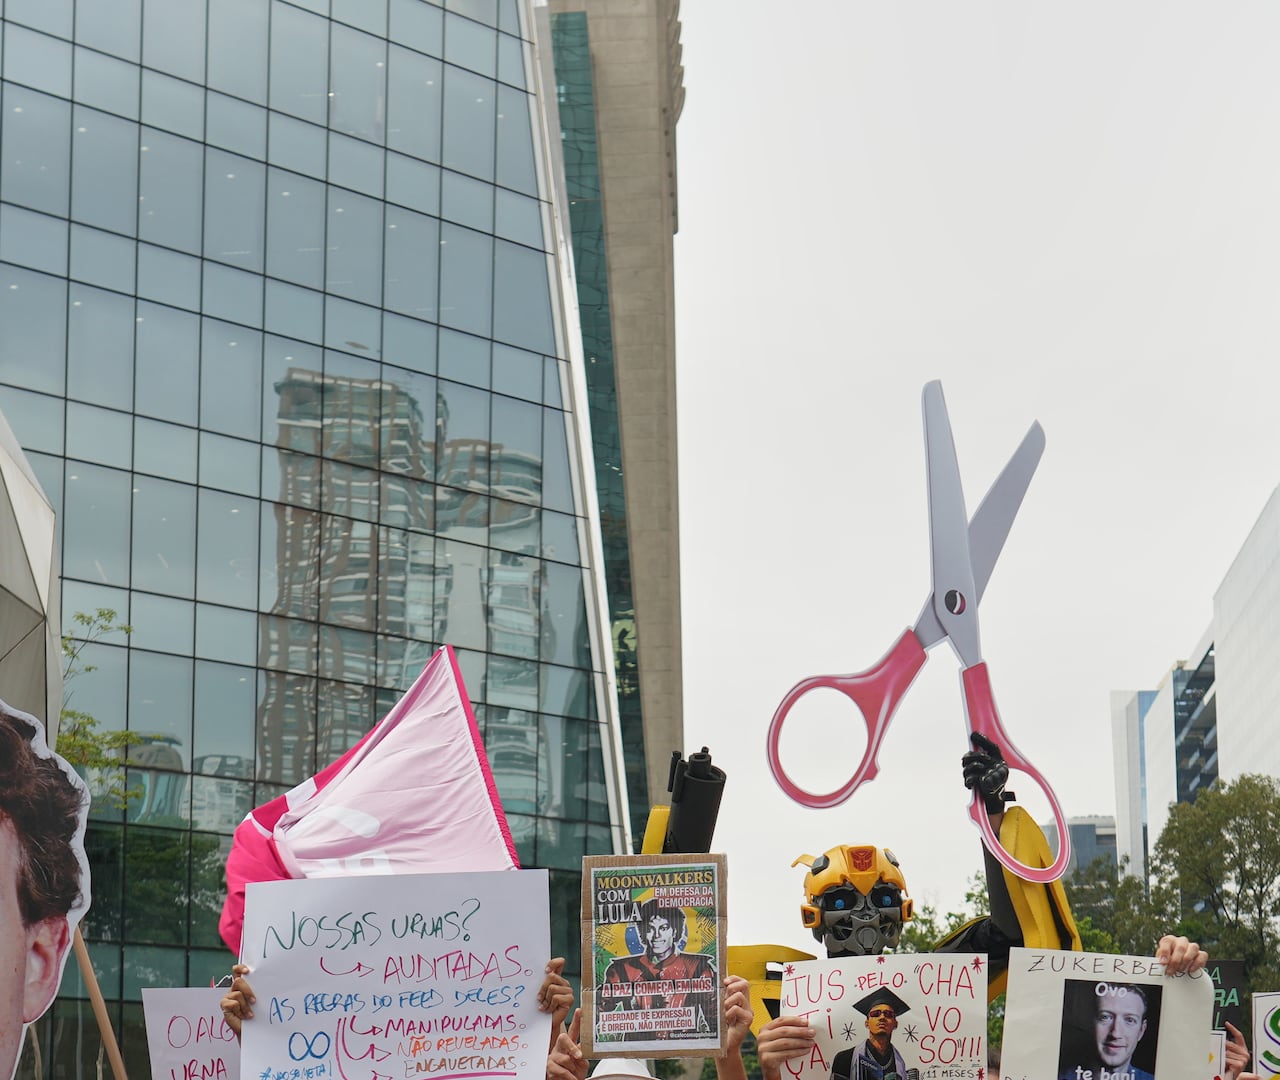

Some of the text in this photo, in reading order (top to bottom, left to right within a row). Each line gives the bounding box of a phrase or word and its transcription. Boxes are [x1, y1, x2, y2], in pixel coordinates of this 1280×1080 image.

[597, 871, 713, 889] MOONWALKERS
[598, 889, 630, 903] COM
[654, 886, 714, 897] EM DEFESA DA
[658, 896, 714, 908] DEMOCRACIA
[598, 902, 642, 924] LULA
[264, 898, 480, 959] NOSSAS URNAS?
[603, 976, 714, 997] A PAZ COMEÇA EM NÓS.
[1095, 982, 1127, 998] Ovo
[269, 996, 295, 1024] AS
[601, 1008, 692, 1022] LIBERDADE DE EXPRESSÃO
[608, 1022, 637, 1032] DIREITO,
[638, 1020, 653, 1030] NÃO
[925, 1006, 962, 1034] VO
[397, 1035, 432, 1058] NÃO
[942, 1070, 974, 1078] MESES
